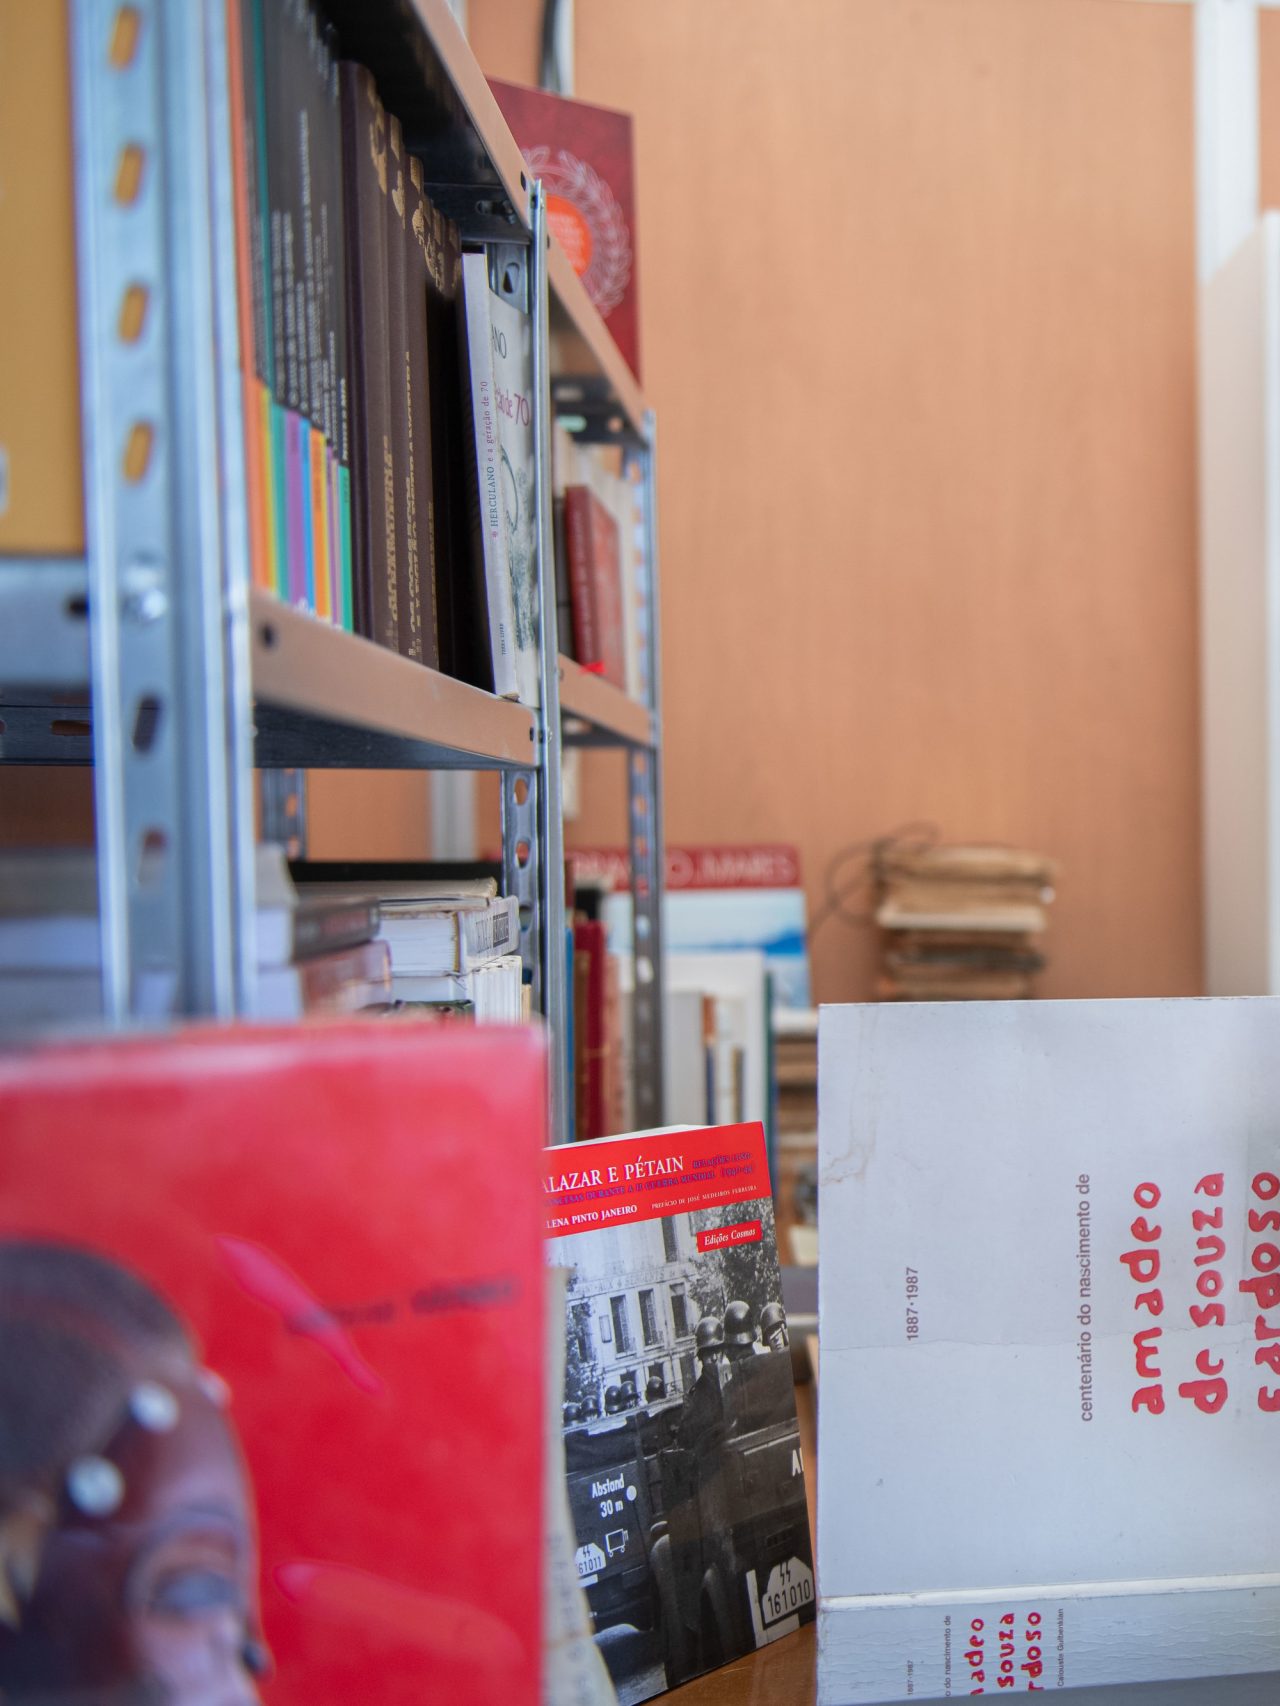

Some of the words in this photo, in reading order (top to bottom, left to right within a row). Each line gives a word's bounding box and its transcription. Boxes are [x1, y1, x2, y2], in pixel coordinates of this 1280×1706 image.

[480, 381, 488, 392] 70
[481, 396, 489, 407] de
[483, 410, 494, 444] geração
[514, 393, 530, 427] 70
[487, 467, 499, 527] HERCULANO
[542, 1169, 603, 1193] LAZAR
[607, 1166, 619, 1183] E
[624, 1155, 684, 1181] PÉTAIN
[1076, 1173, 1090, 1197] de
[571, 1211, 599, 1225] PINTO
[601, 1204, 638, 1221] JANEIRO
[678, 1197, 686, 1205] DE
[687, 1193, 700, 1205] JOSÉ
[704, 1231, 729, 1248] Edições
[731, 1228, 756, 1242] Cosmos
[1076, 1200, 1092, 1298] nascimento
[1189, 1173, 1226, 1328] souza
[1077, 1303, 1092, 1326] do
[1119, 1182, 1165, 1415] amadeo
[1076, 1330, 1093, 1422] centenário
[1178, 1349, 1228, 1414] de
[592, 1472, 625, 1499] Abstand
[600, 1499, 614, 1518] 30
[615, 1500, 624, 1512] m
[575, 1555, 603, 1575] 61011
[768, 1578, 811, 1617] 161010
[943, 1615, 951, 1626] de
[1056, 1608, 1064, 1651] Gulbenkian
[943, 1628, 951, 1676] nascimento
[964, 1618, 985, 1696] adeo
[997, 1613, 1015, 1688] souza
[1021, 1612, 1044, 1692] rdoso
[943, 1677, 951, 1689] do
[1057, 1652, 1065, 1687] Calouste
